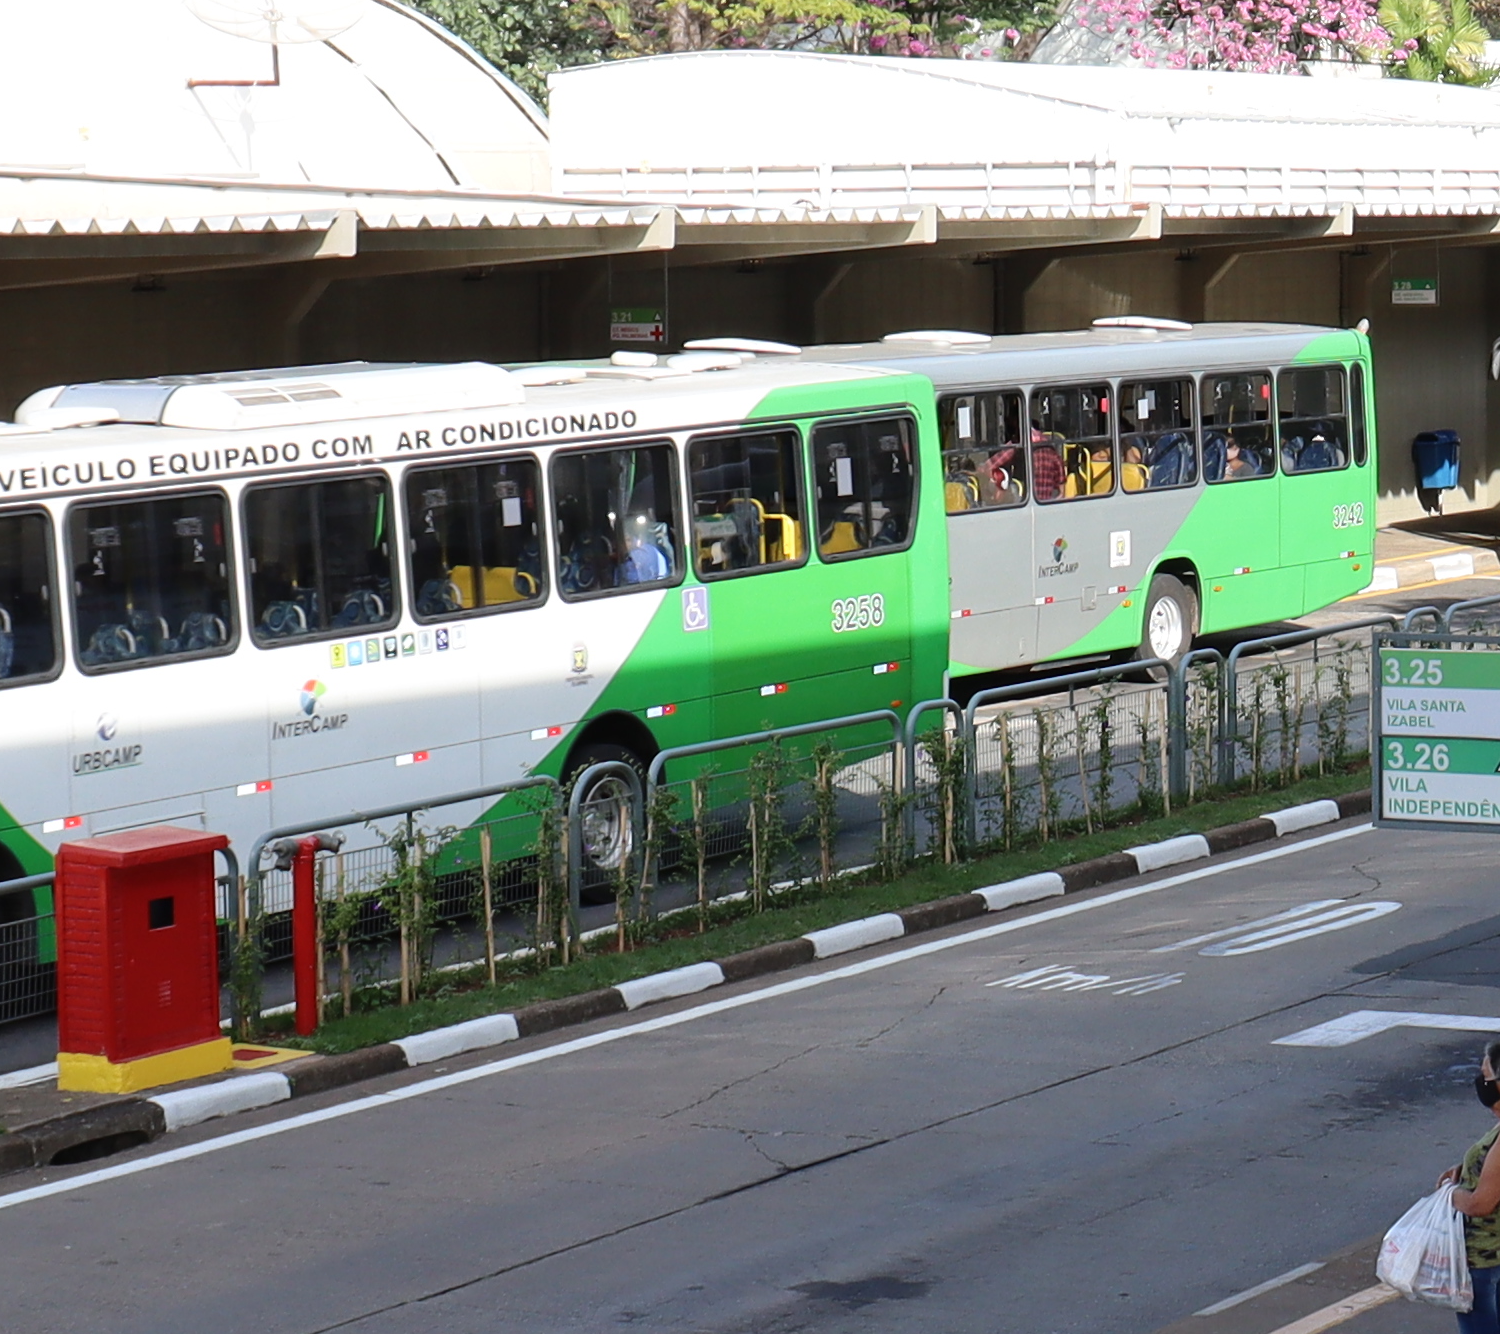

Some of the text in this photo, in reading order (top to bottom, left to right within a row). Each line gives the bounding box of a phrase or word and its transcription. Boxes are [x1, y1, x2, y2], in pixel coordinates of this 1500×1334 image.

[149, 442, 301, 477] EQUIPADO
[311, 435, 374, 459] COM
[396, 430, 432, 452] AR
[441, 410, 637, 447] CONDICIONADO
[1332, 502, 1364, 529] 3242
[831, 592, 885, 634] 3258
[1384, 657, 1443, 686] 3.25
[1387, 698, 1466, 713] VILA SANTA
[1387, 715, 1435, 728] IZABEL
[73, 744, 143, 773] URBCAMP
[1387, 741, 1449, 771] 3.26
[1388, 776, 1428, 793] VILA
[1148, 898, 1403, 957] 10
